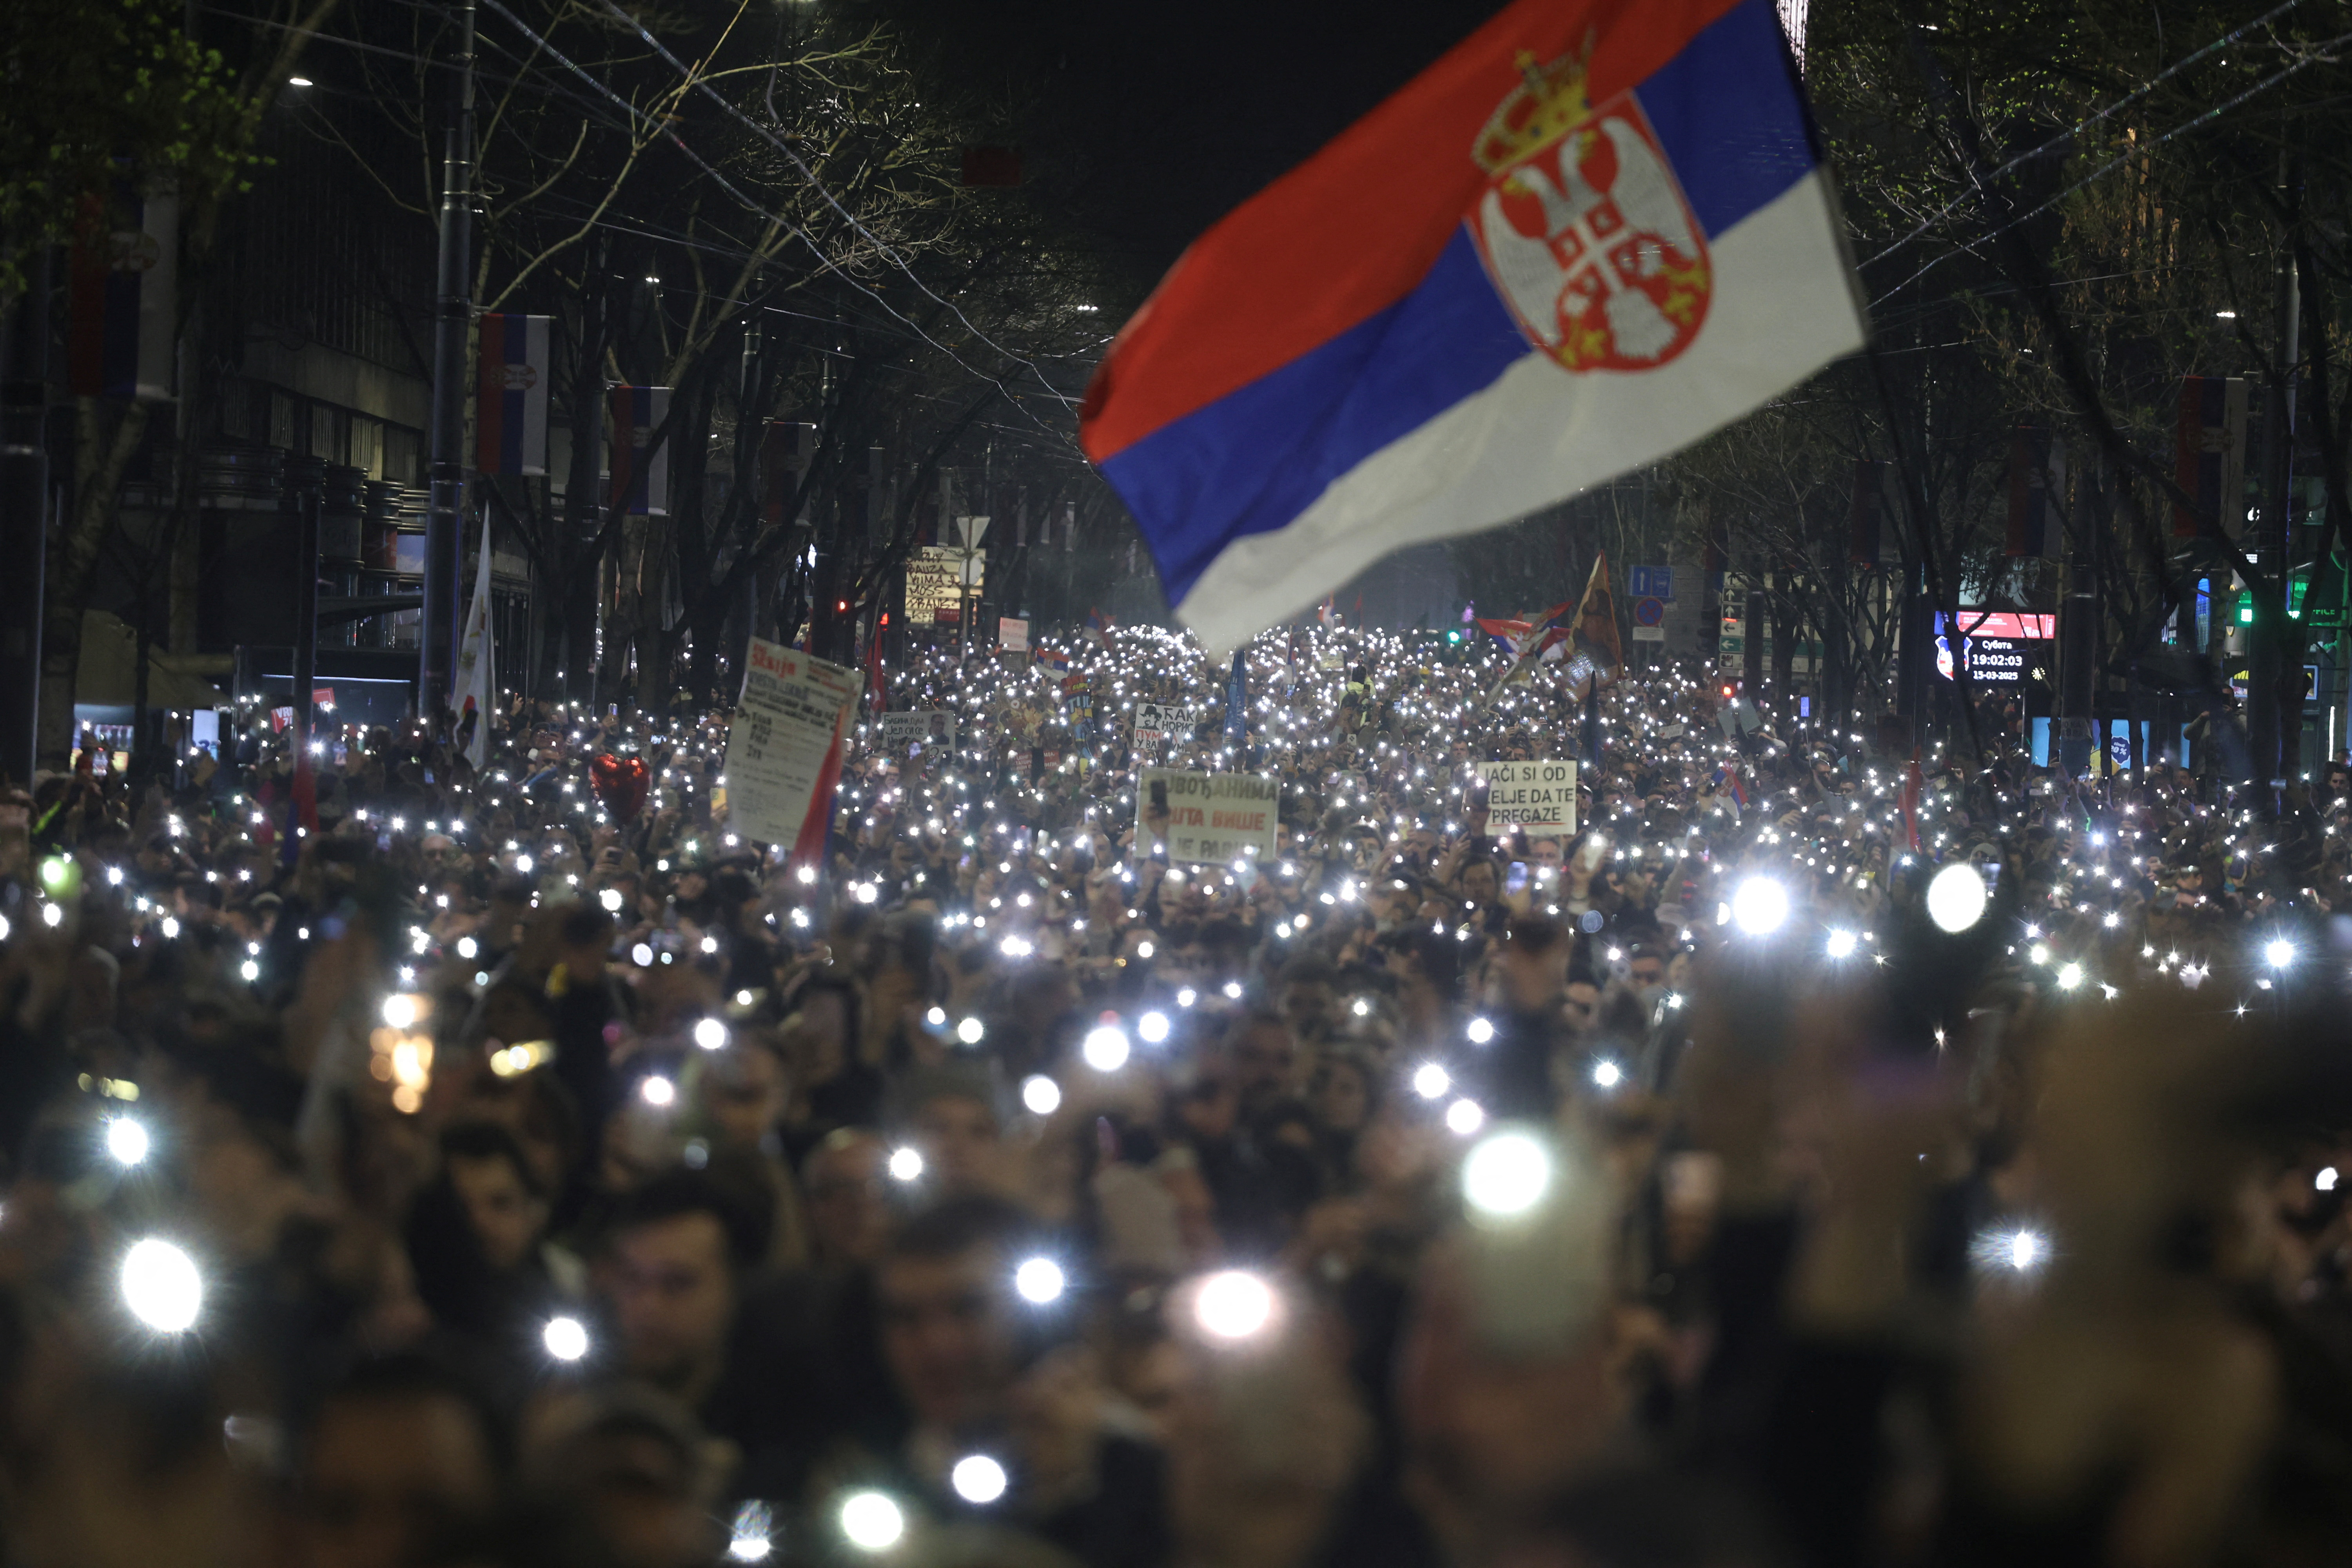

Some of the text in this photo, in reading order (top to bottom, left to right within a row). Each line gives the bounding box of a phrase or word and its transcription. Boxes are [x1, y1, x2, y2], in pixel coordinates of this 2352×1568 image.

[1982, 640, 2013, 651] Субота
[1972, 654, 2023, 666] 19:02:03
[1973, 671, 2018, 681] 15-03-2025
[1523, 767, 1536, 780] SI
[1543, 767, 1566, 781] OD
[1488, 788, 1574, 804] ELJE DA TE
[1212, 809, 1266, 831] ВИШЕ
[1493, 807, 1561, 824] PREGAZE
